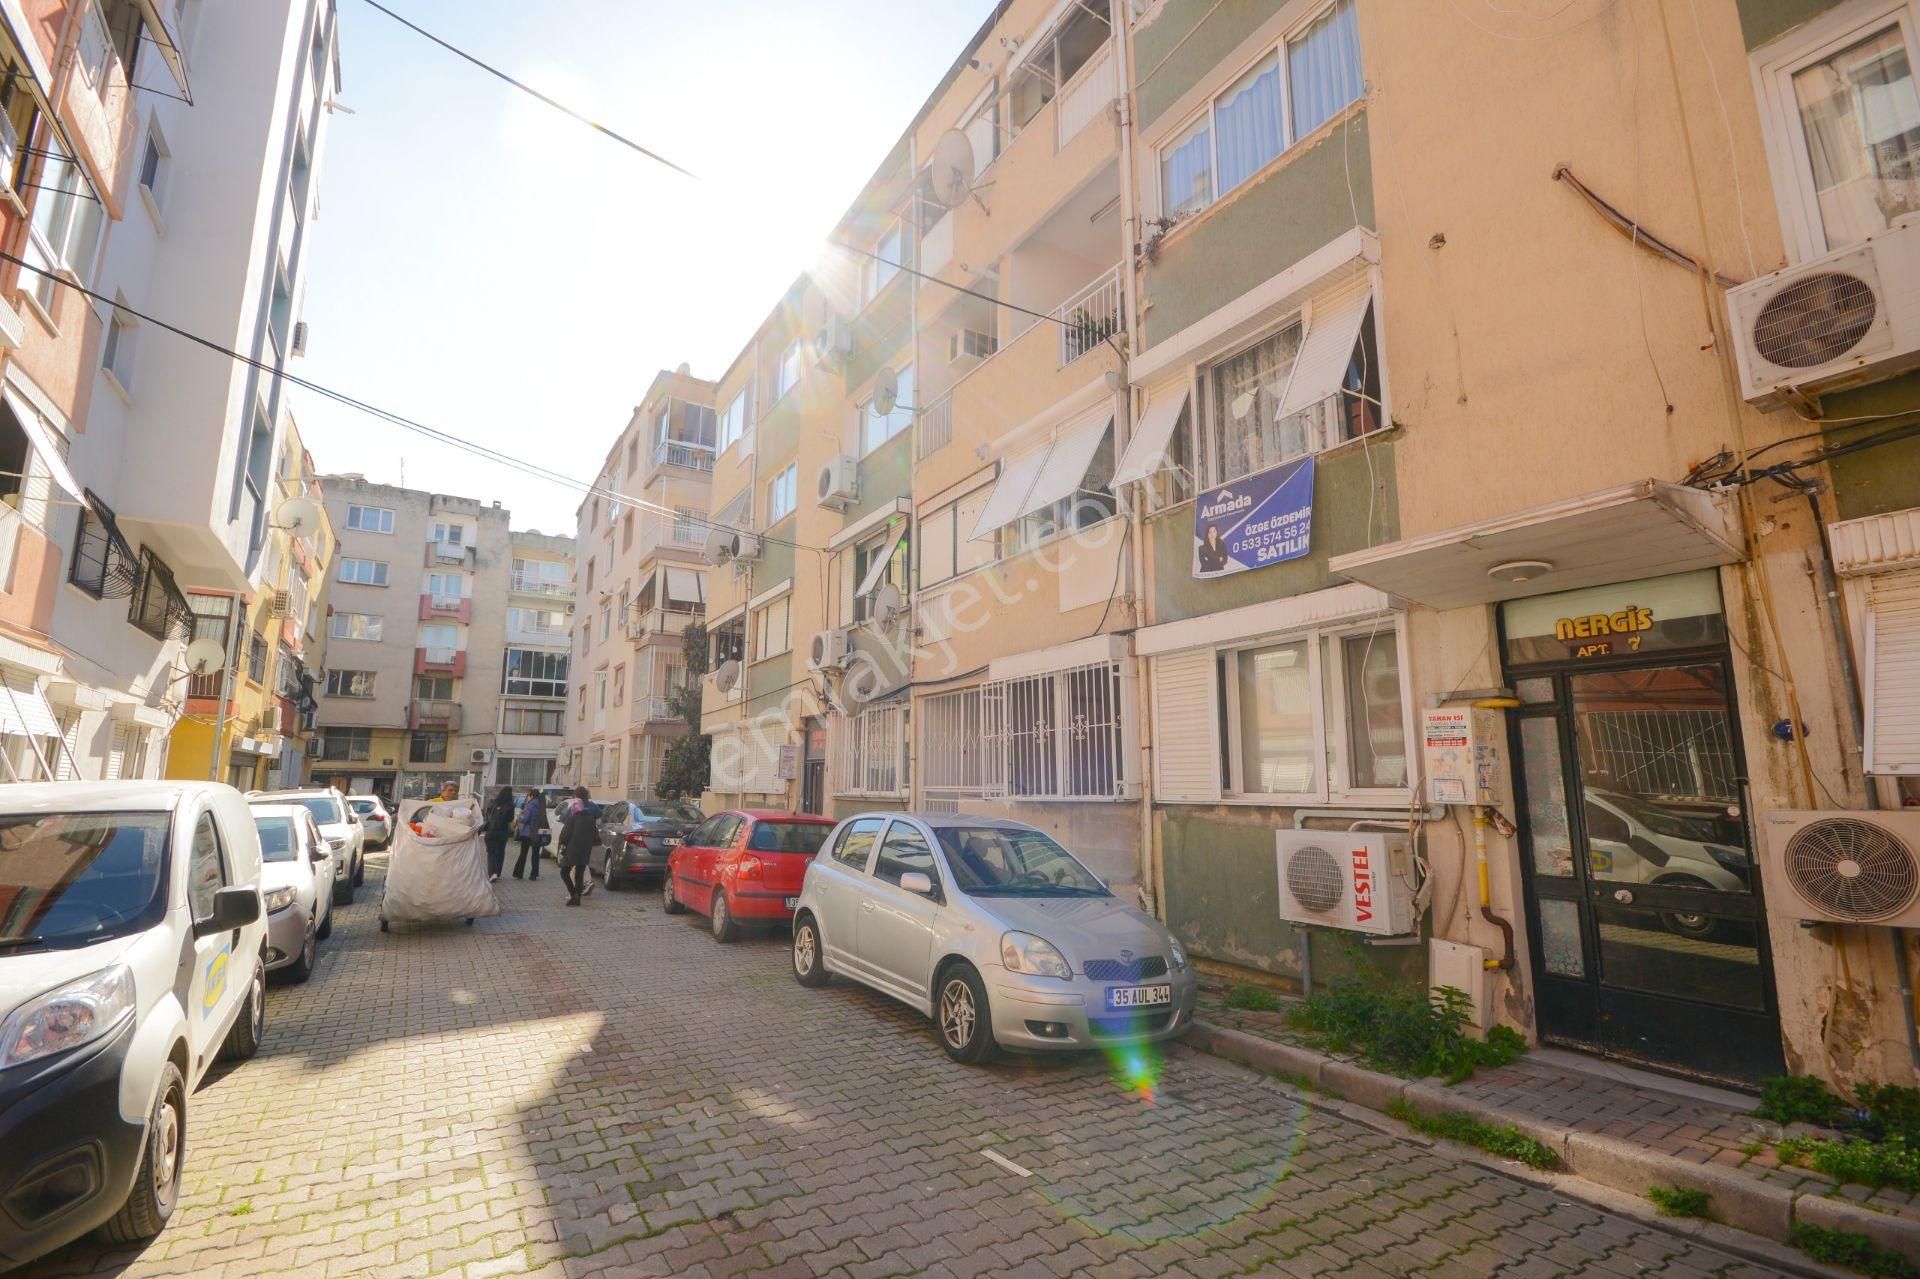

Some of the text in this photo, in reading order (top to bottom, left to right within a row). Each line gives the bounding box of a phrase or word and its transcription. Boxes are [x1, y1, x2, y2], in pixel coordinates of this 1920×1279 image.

[1200, 494, 1252, 519] Armada
[1232, 542, 1240, 553] 0
[1241, 536, 1261, 551] 533
[1263, 530, 1281, 545] 574
[1284, 525, 1297, 539] 56
[1245, 521, 1270, 536] ÖZGE
[1257, 534, 1310, 561] SATILIK
[1577, 636, 1641, 657] APT. 7
[1352, 845, 1373, 922] VESTEL
[1115, 987, 1169, 1005] 35 AUL 344
